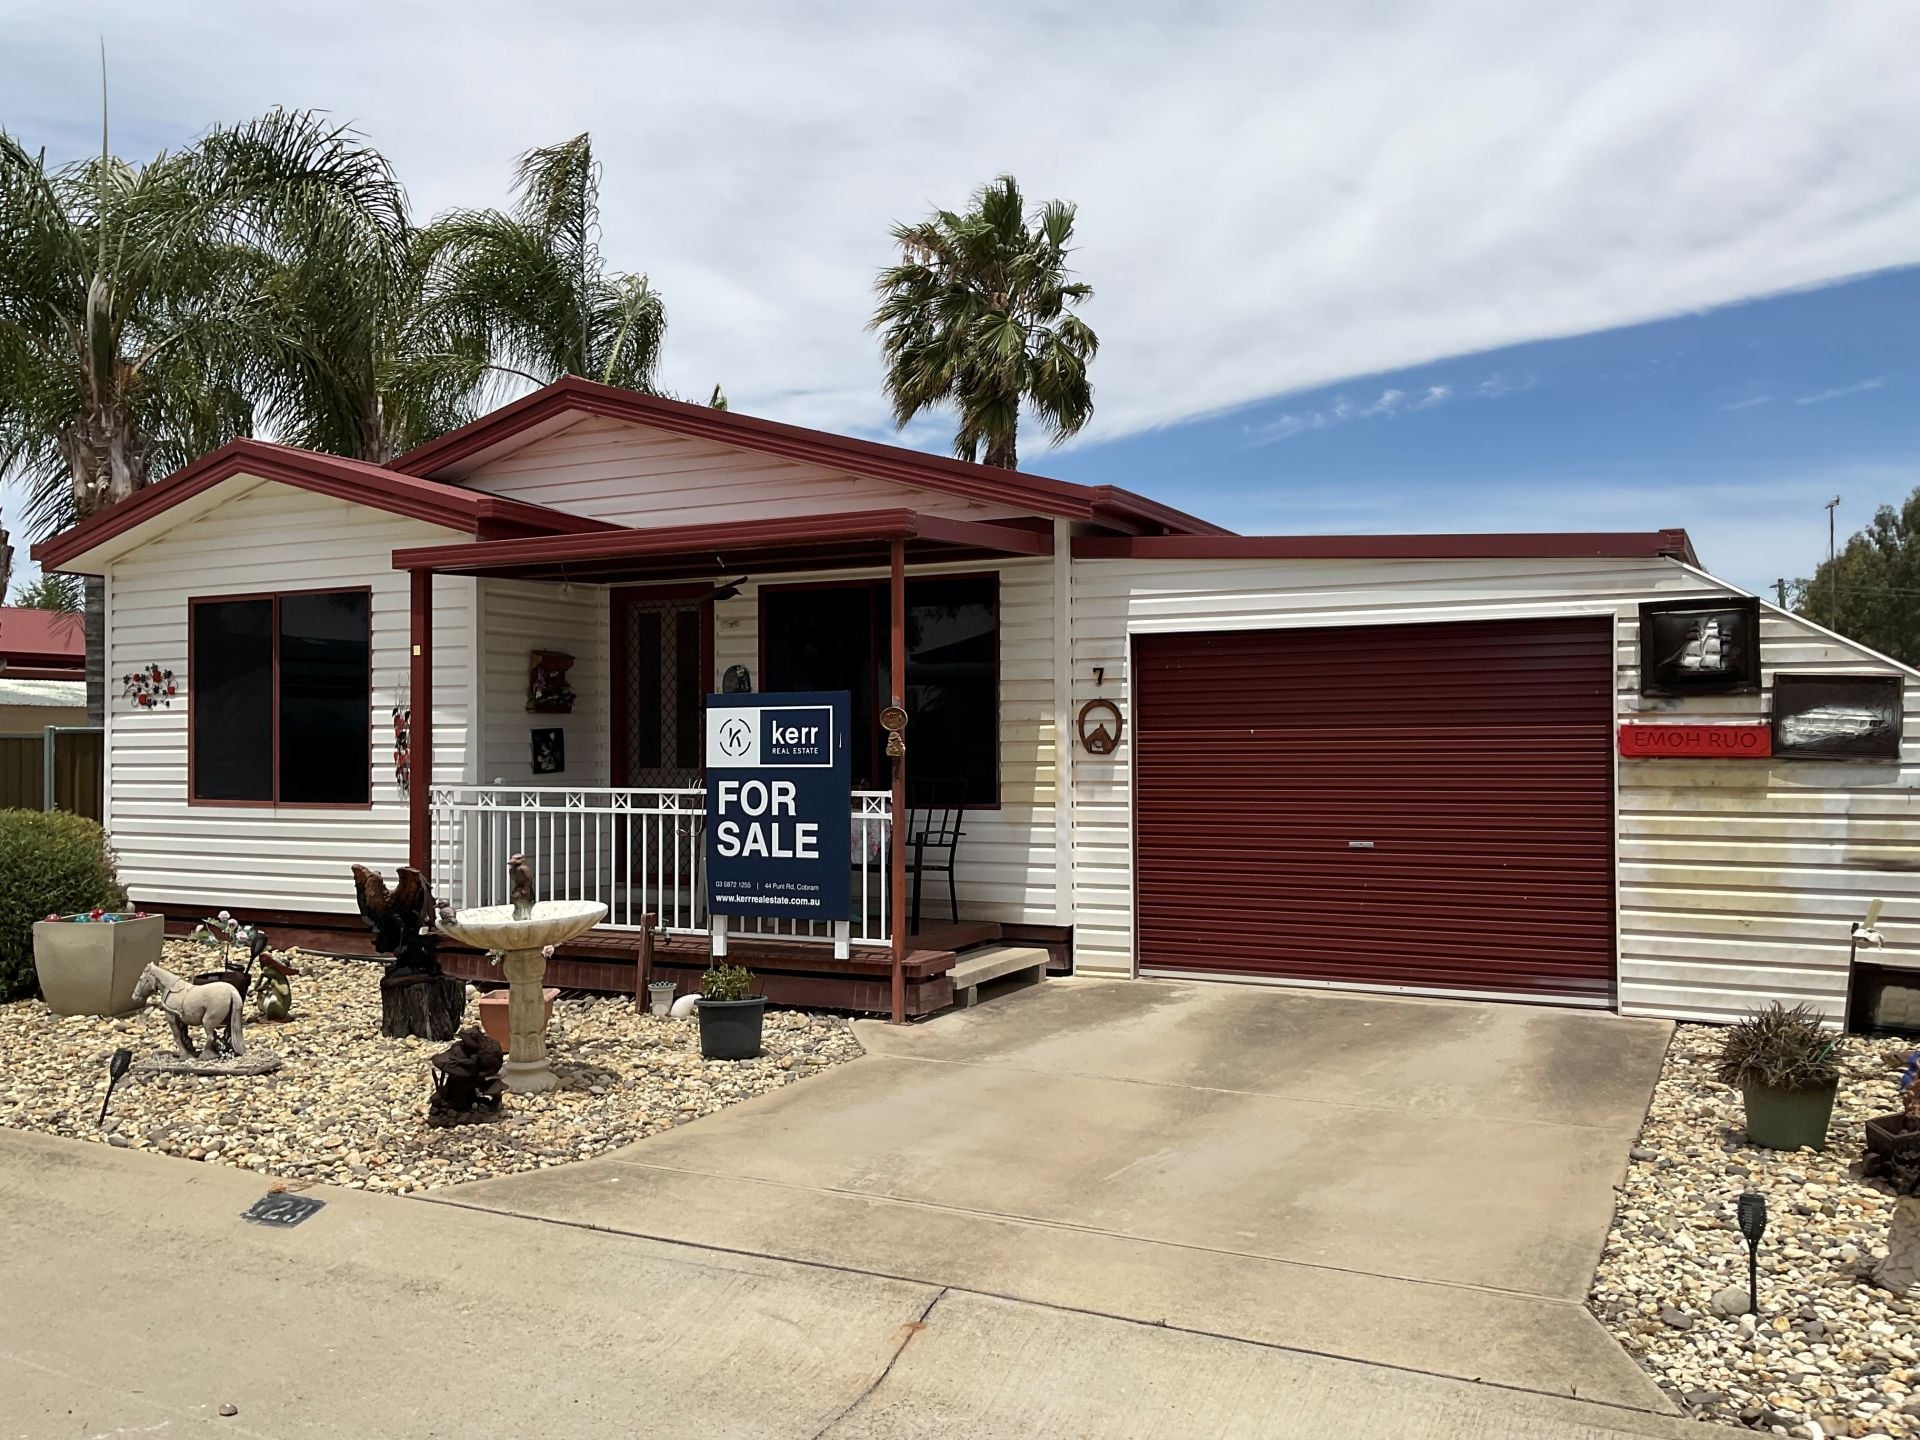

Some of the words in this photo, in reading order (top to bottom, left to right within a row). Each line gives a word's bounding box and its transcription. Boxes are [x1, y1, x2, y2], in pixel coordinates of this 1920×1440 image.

[1093, 667, 1104, 686] 7
[772, 720, 819, 745] kerr
[1634, 731, 1700, 748] EMOH
[1709, 732, 1757, 749] RUO
[771, 747, 790, 755] REAL
[792, 747, 819, 755] ESTATE
[718, 779, 797, 816] FOR
[716, 820, 819, 859] SALE
[715, 880, 723, 888] 03
[723, 880, 737, 888] 5872
[738, 881, 752, 889] 1255
[796, 883, 820, 891] Cobram
[715, 893, 821, 906] www.kerrrealestate.com.au
